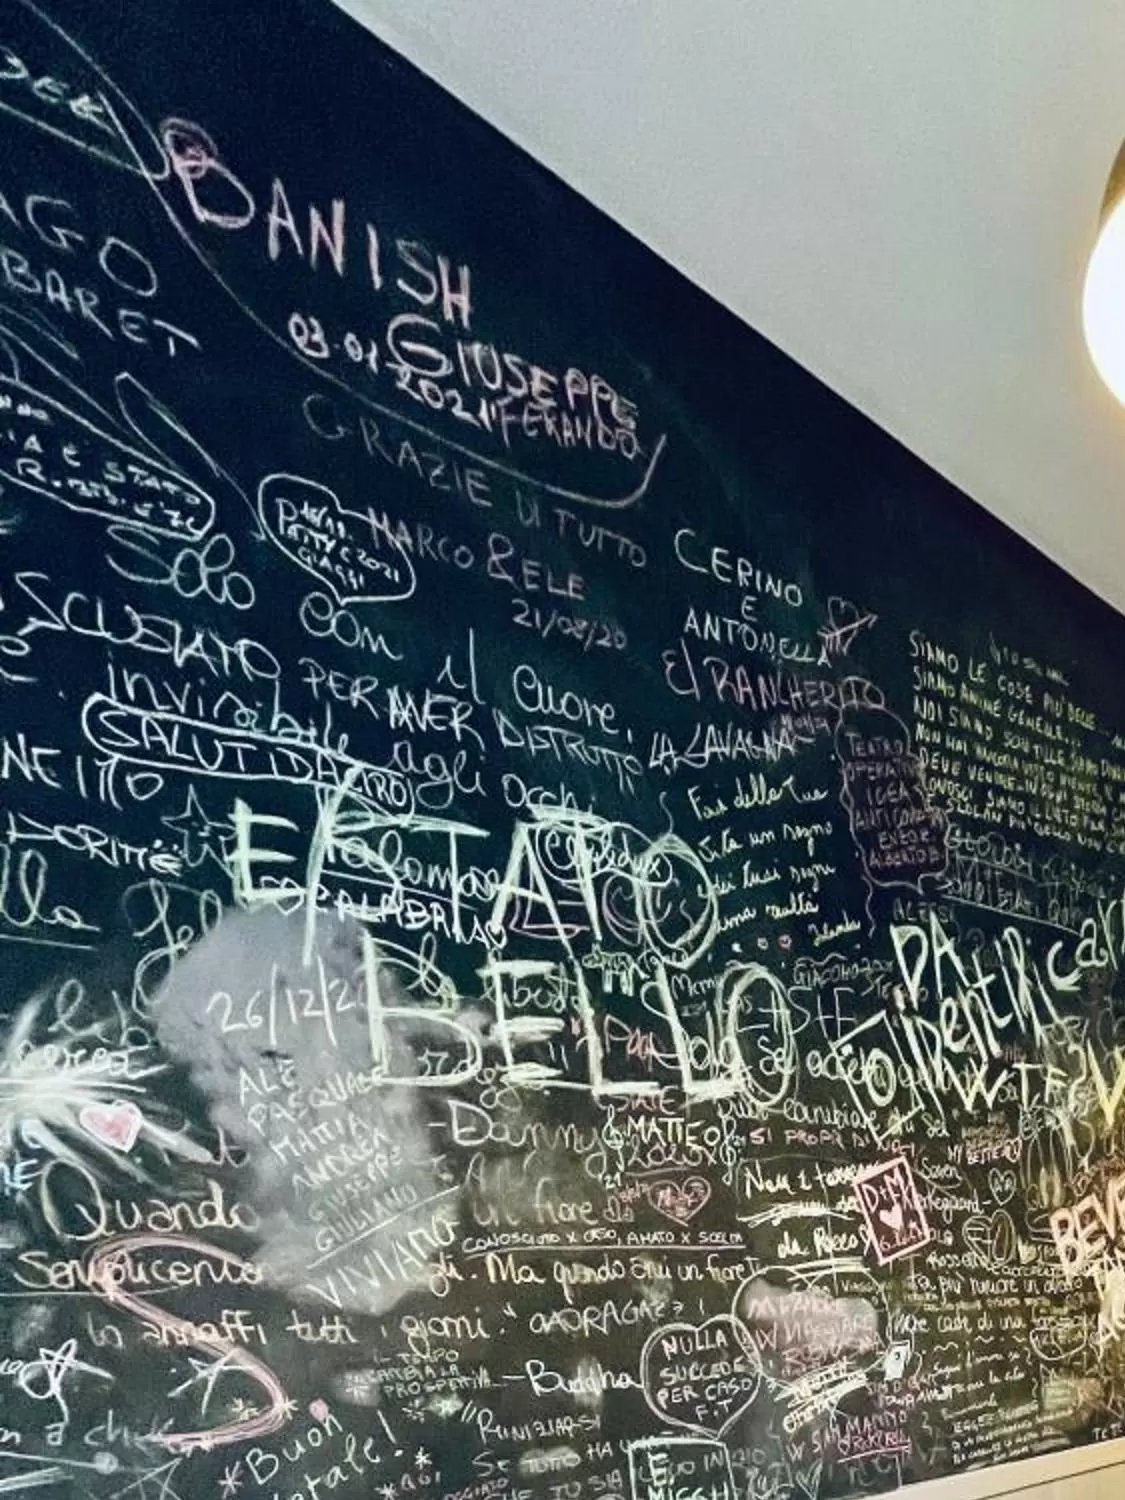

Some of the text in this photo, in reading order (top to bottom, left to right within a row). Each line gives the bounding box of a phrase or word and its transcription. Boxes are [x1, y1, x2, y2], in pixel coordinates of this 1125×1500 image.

[172, 153, 472, 328] DANISH
[387, 313, 639, 430] GIUSEPPE
[673, 527, 804, 607] CERINO
[684, 608, 833, 668] ANTONELLA
[660, 1328, 729, 1361] NULLA
[705, 1377, 752, 1401] CASO
[245, 1413, 344, 1485] Buon
